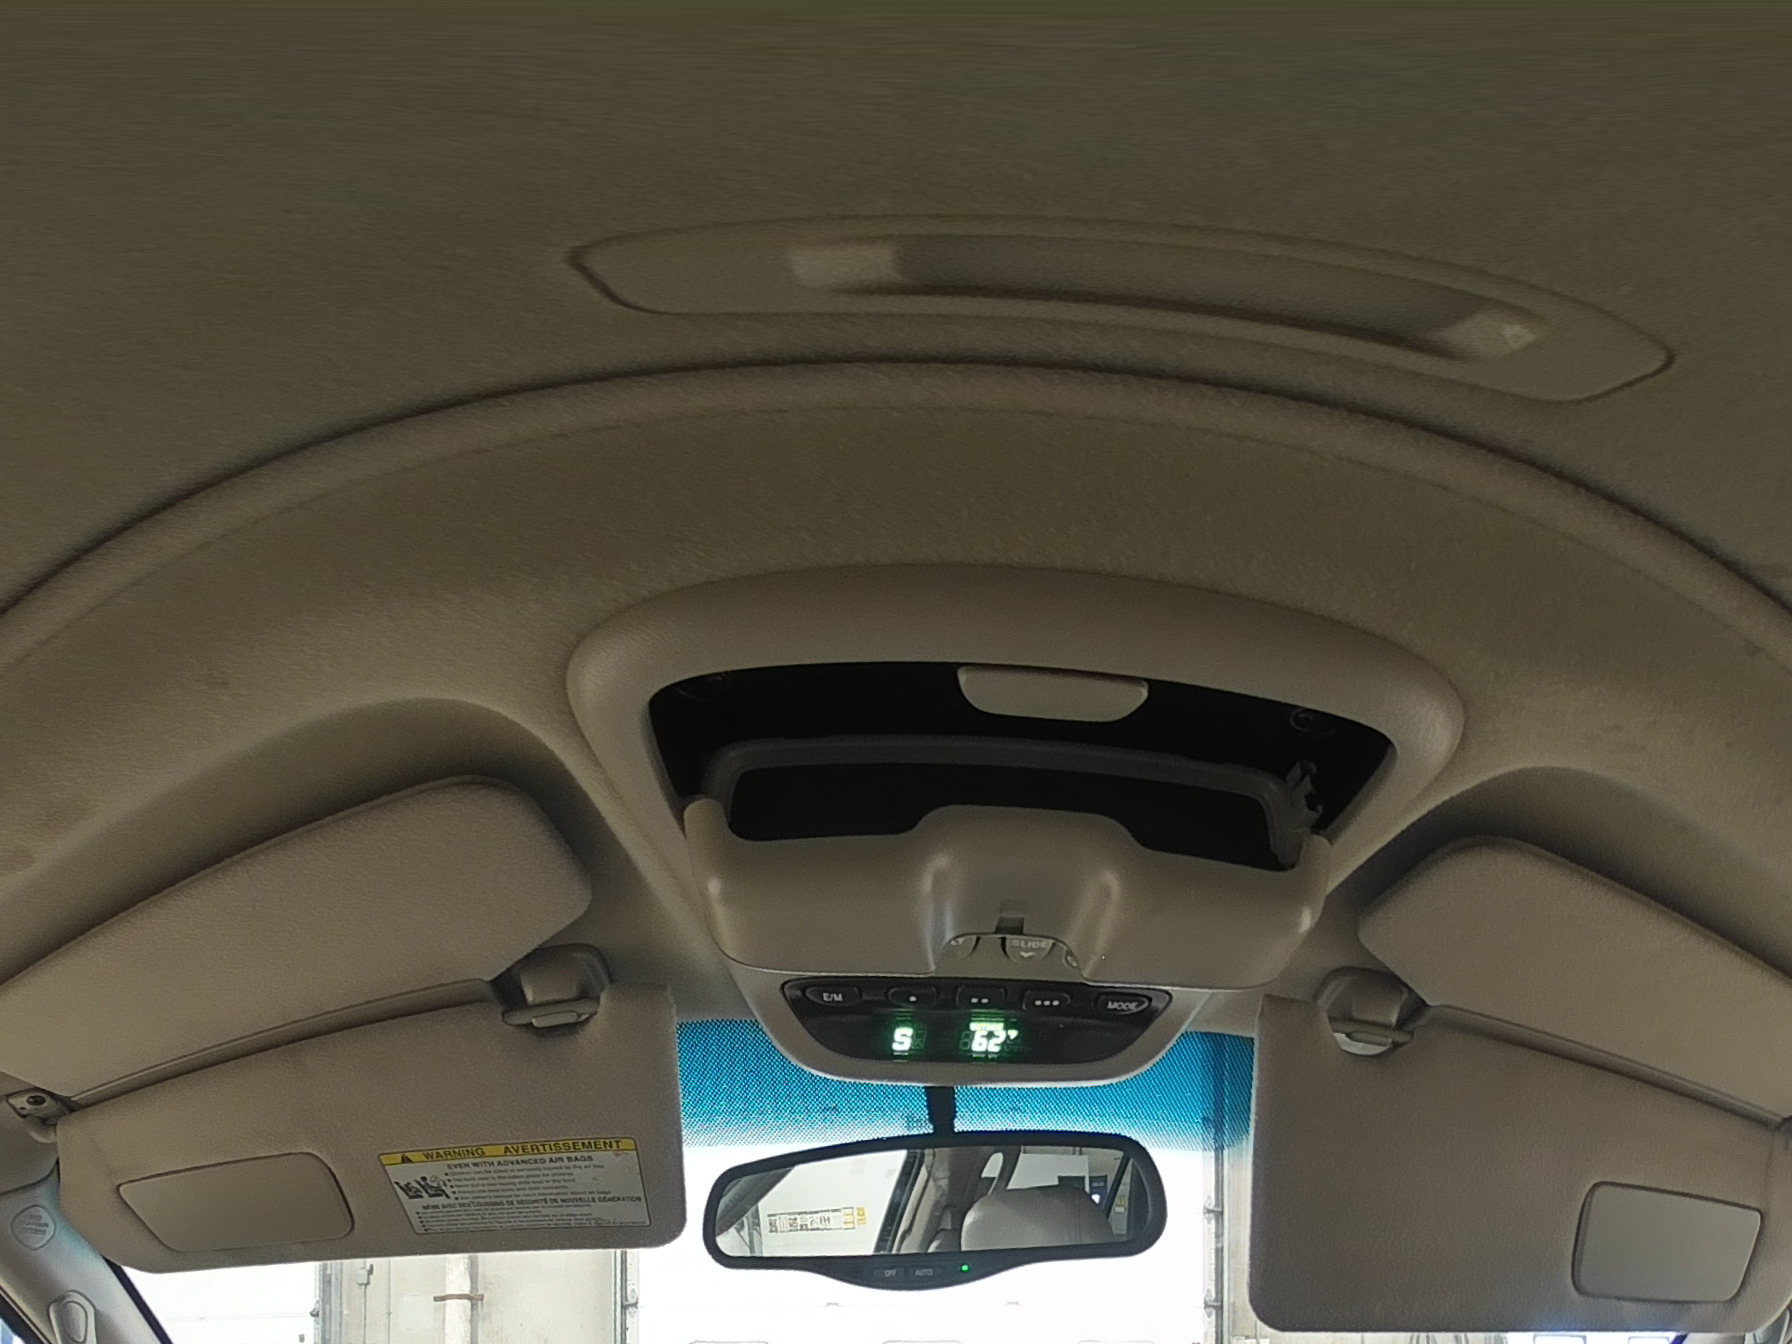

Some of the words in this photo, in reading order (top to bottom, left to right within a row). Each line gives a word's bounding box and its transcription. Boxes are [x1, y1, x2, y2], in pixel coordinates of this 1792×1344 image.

[1011, 938, 1051, 950] SLIDE
[823, 992, 844, 1003] E/M
[1107, 999, 1139, 1011] MODE
[892, 1026, 914, 1052] S
[422, 1147, 486, 1161] WARNING
[502, 1140, 623, 1155] AVERTISSEMENT
[447, 1162, 470, 1171] EVEN
[472, 1160, 495, 1169] WITH
[496, 1158, 547, 1168] ADVANCED
[567, 1155, 594, 1163] BAGS
